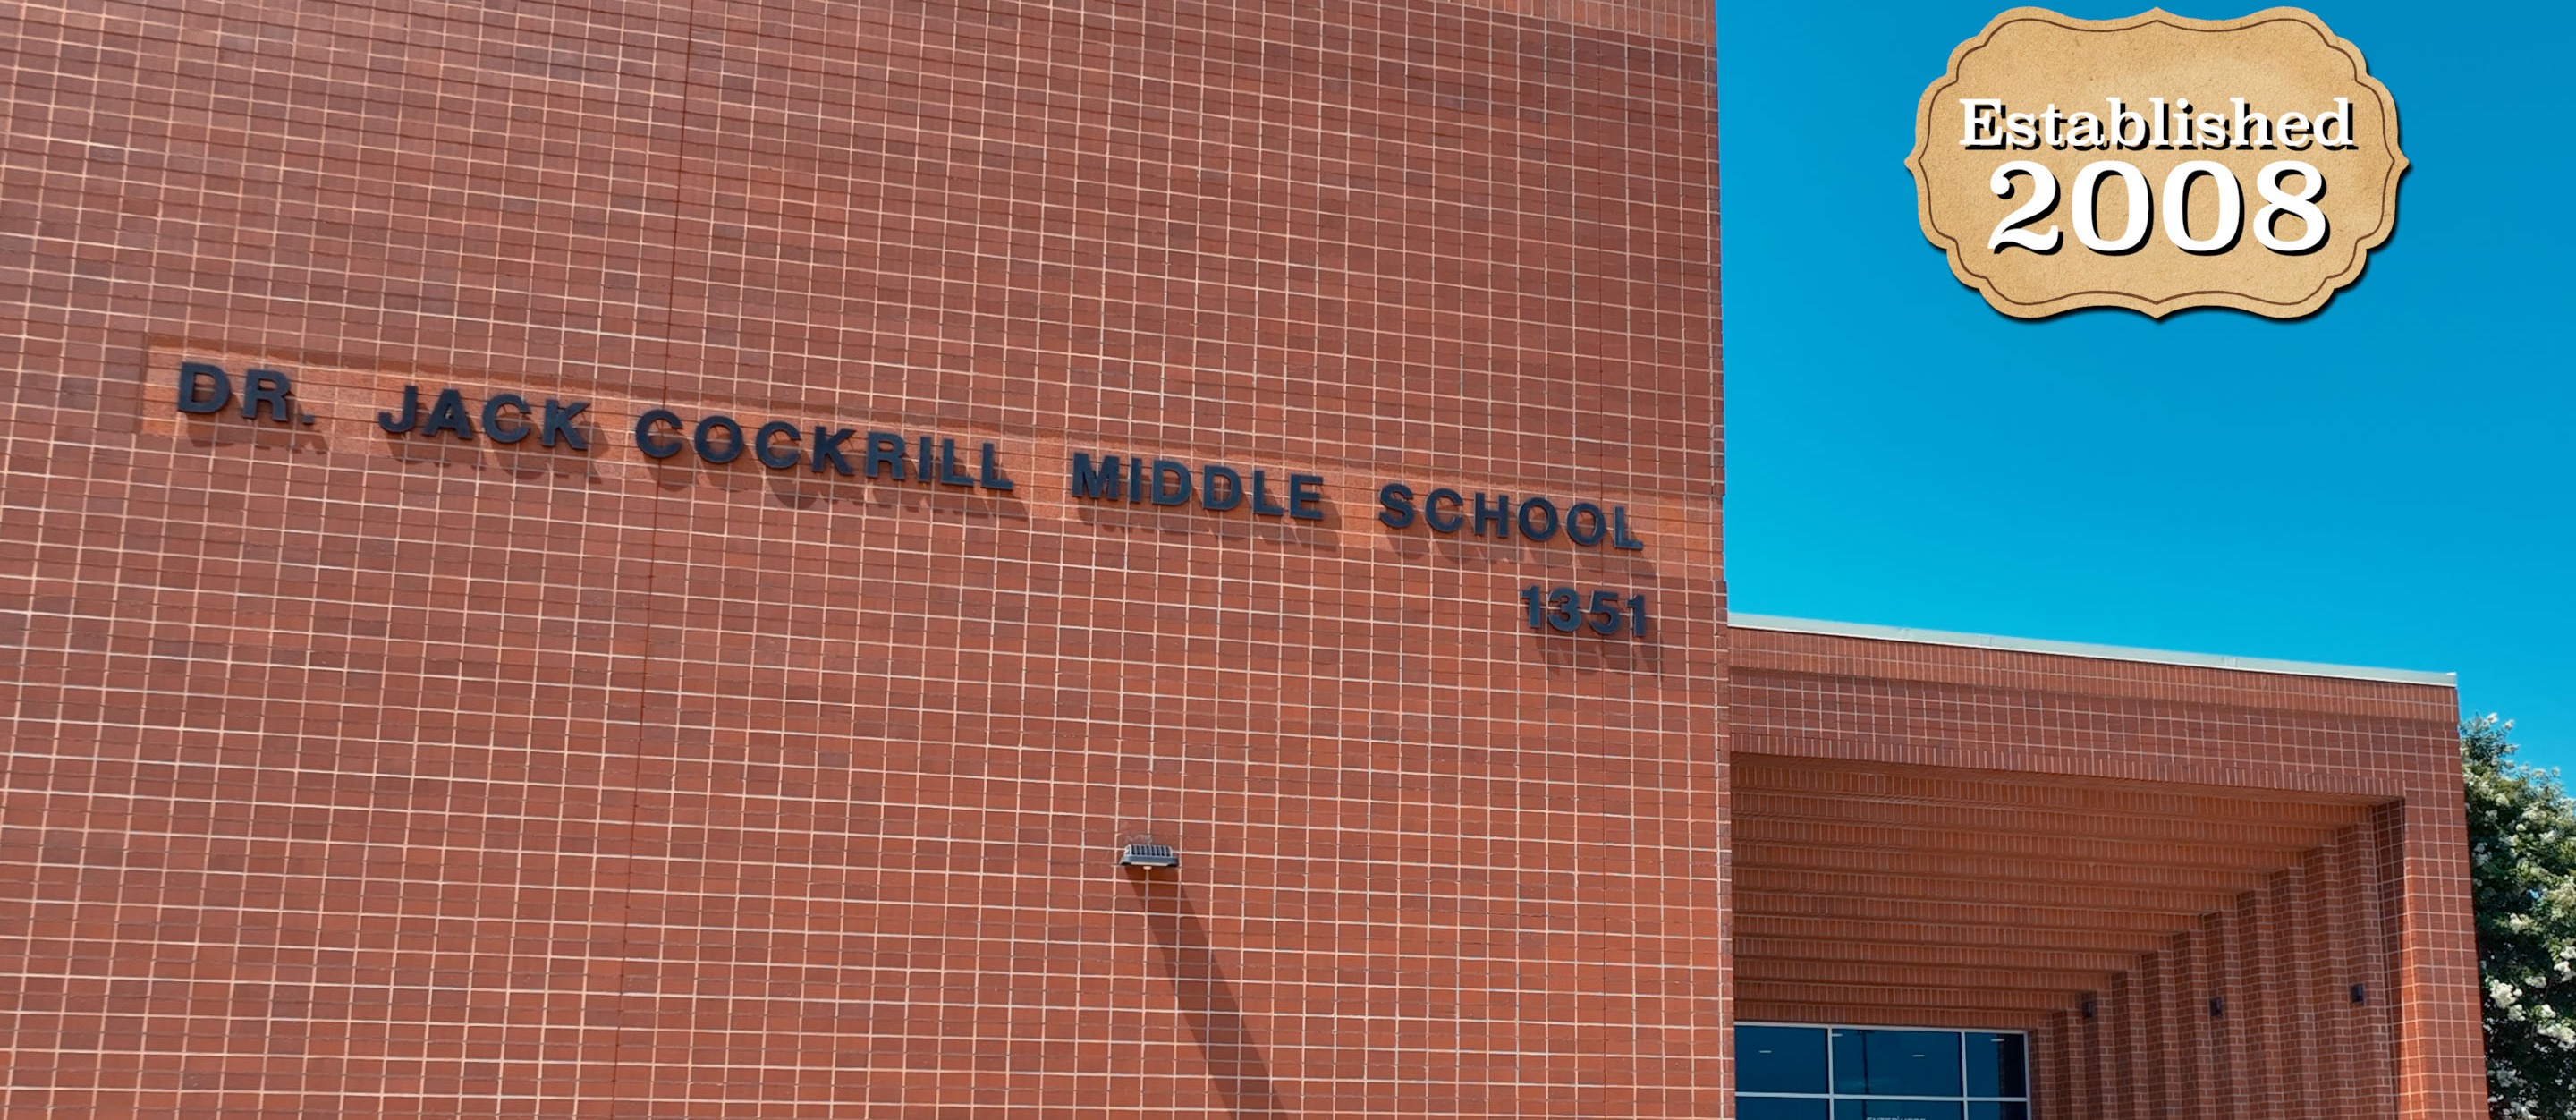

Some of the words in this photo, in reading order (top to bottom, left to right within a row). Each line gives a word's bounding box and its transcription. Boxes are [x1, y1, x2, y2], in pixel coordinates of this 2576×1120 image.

[177, 361, 316, 426] DR.
[377, 385, 591, 451] JACK
[634, 409, 1015, 491] COCKRILL
[1072, 452, 1325, 521] MIDDLE
[1377, 482, 1644, 551] SCHOOL
[1521, 584, 1648, 638] 1351
